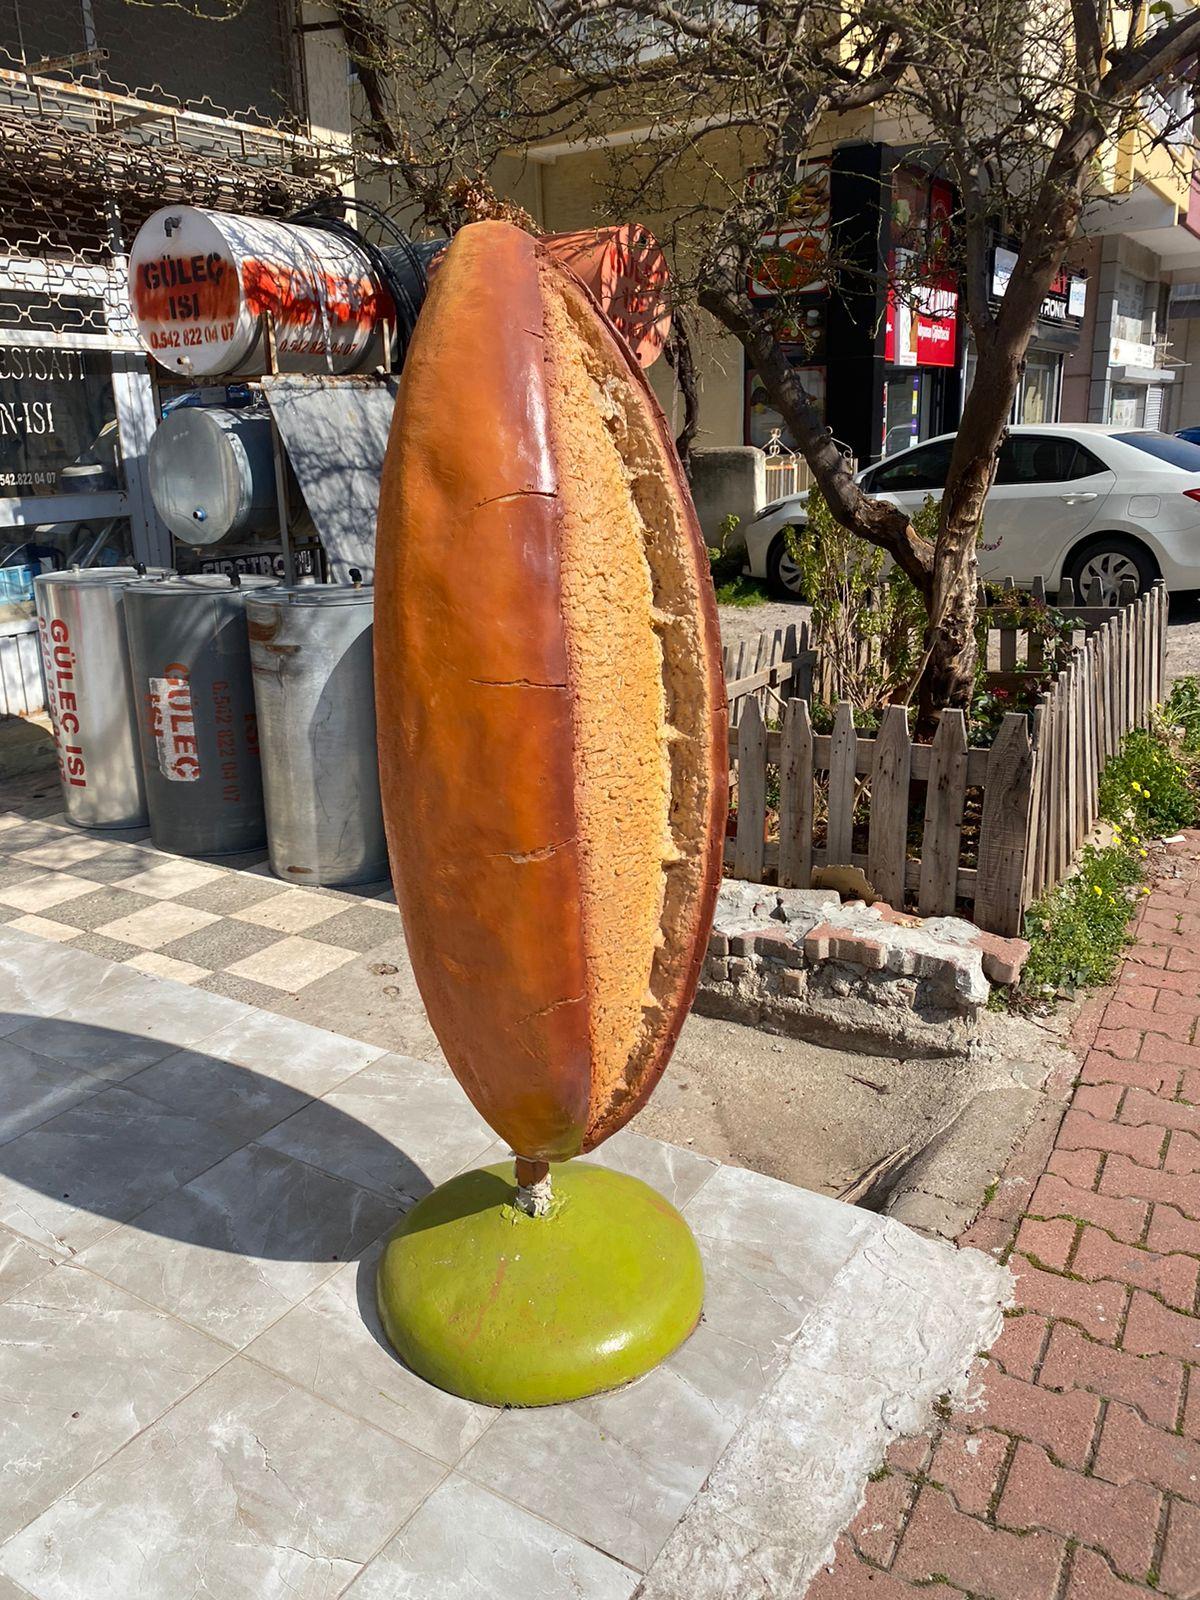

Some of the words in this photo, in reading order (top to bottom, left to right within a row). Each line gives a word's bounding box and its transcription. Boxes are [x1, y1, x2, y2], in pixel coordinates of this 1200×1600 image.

[143, 251, 224, 289] GÜLEÇ
[168, 293, 201, 321] ISI
[183, 327, 203, 346] 822
[221, 322, 235, 341] 07
[34, 472, 45, 485] 04
[46, 471, 56, 484] 07
[50, 618, 80, 735] GÜLEÇ
[65, 745, 87, 787] ISI
